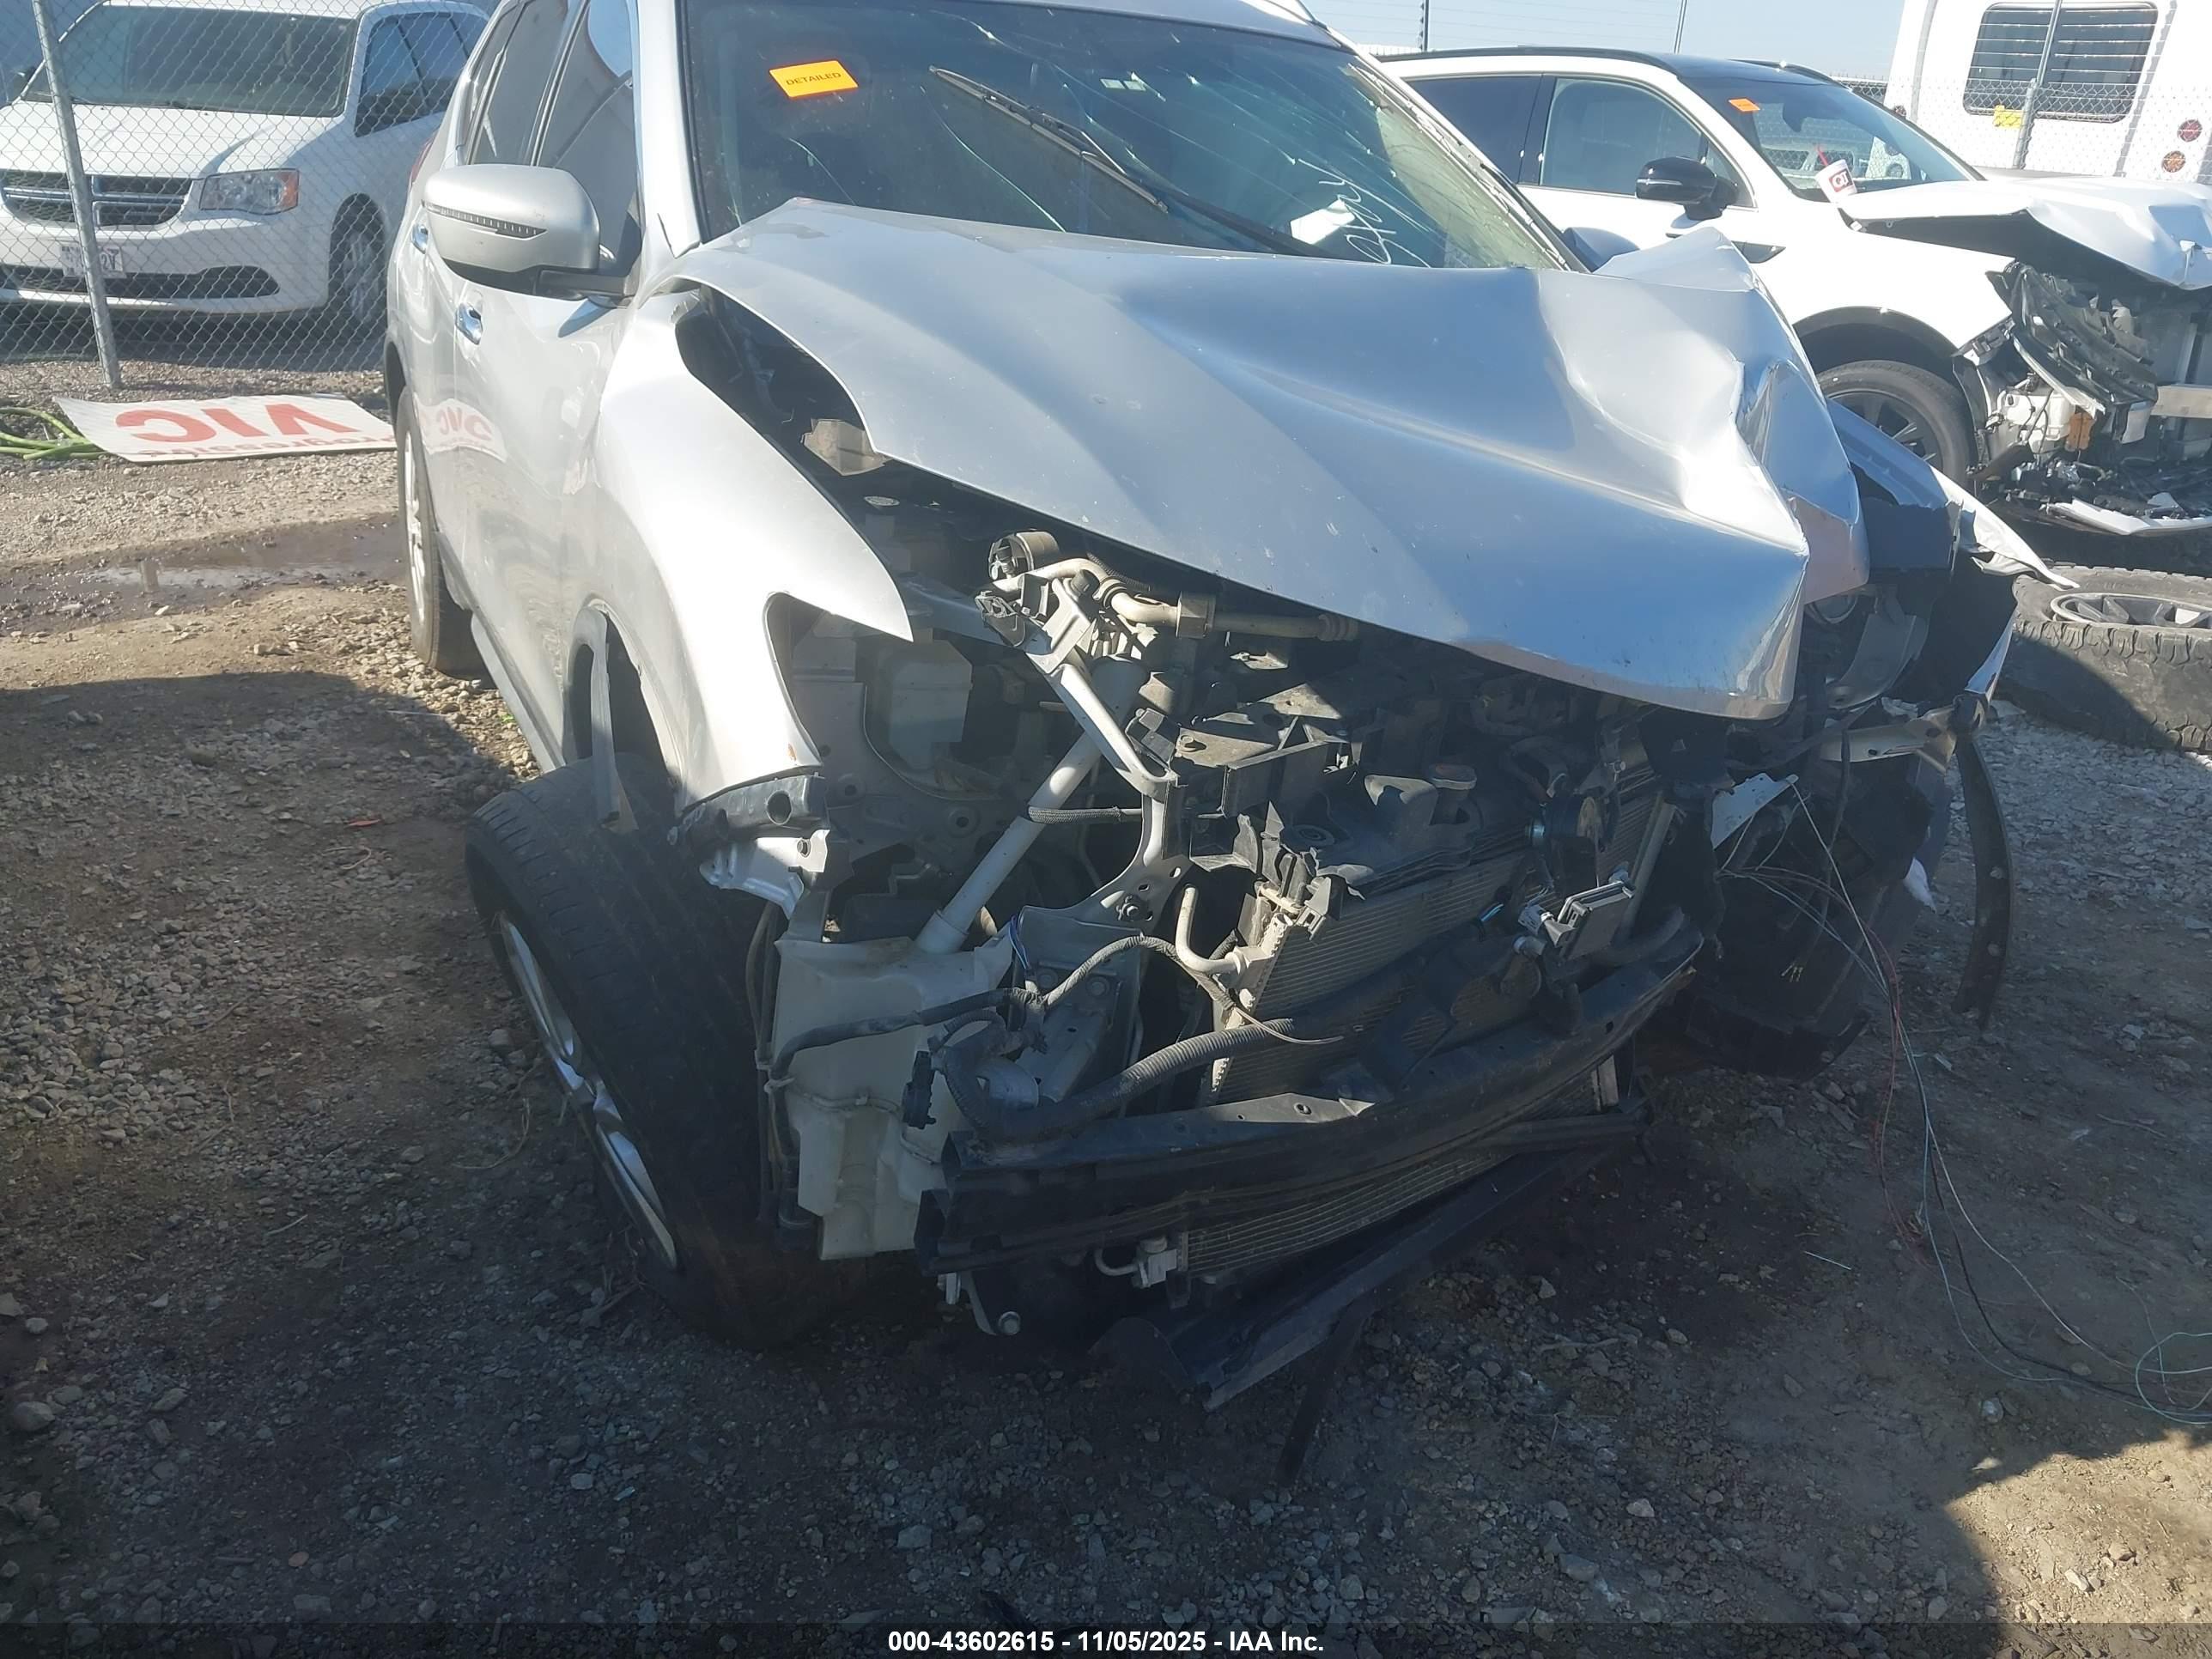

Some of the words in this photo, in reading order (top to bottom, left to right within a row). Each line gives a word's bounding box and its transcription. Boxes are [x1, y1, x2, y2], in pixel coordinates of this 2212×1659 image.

[786, 72, 842, 86] DETAILED
[1832, 171, 1850, 188] QT
[115, 403, 362, 443] VIC
